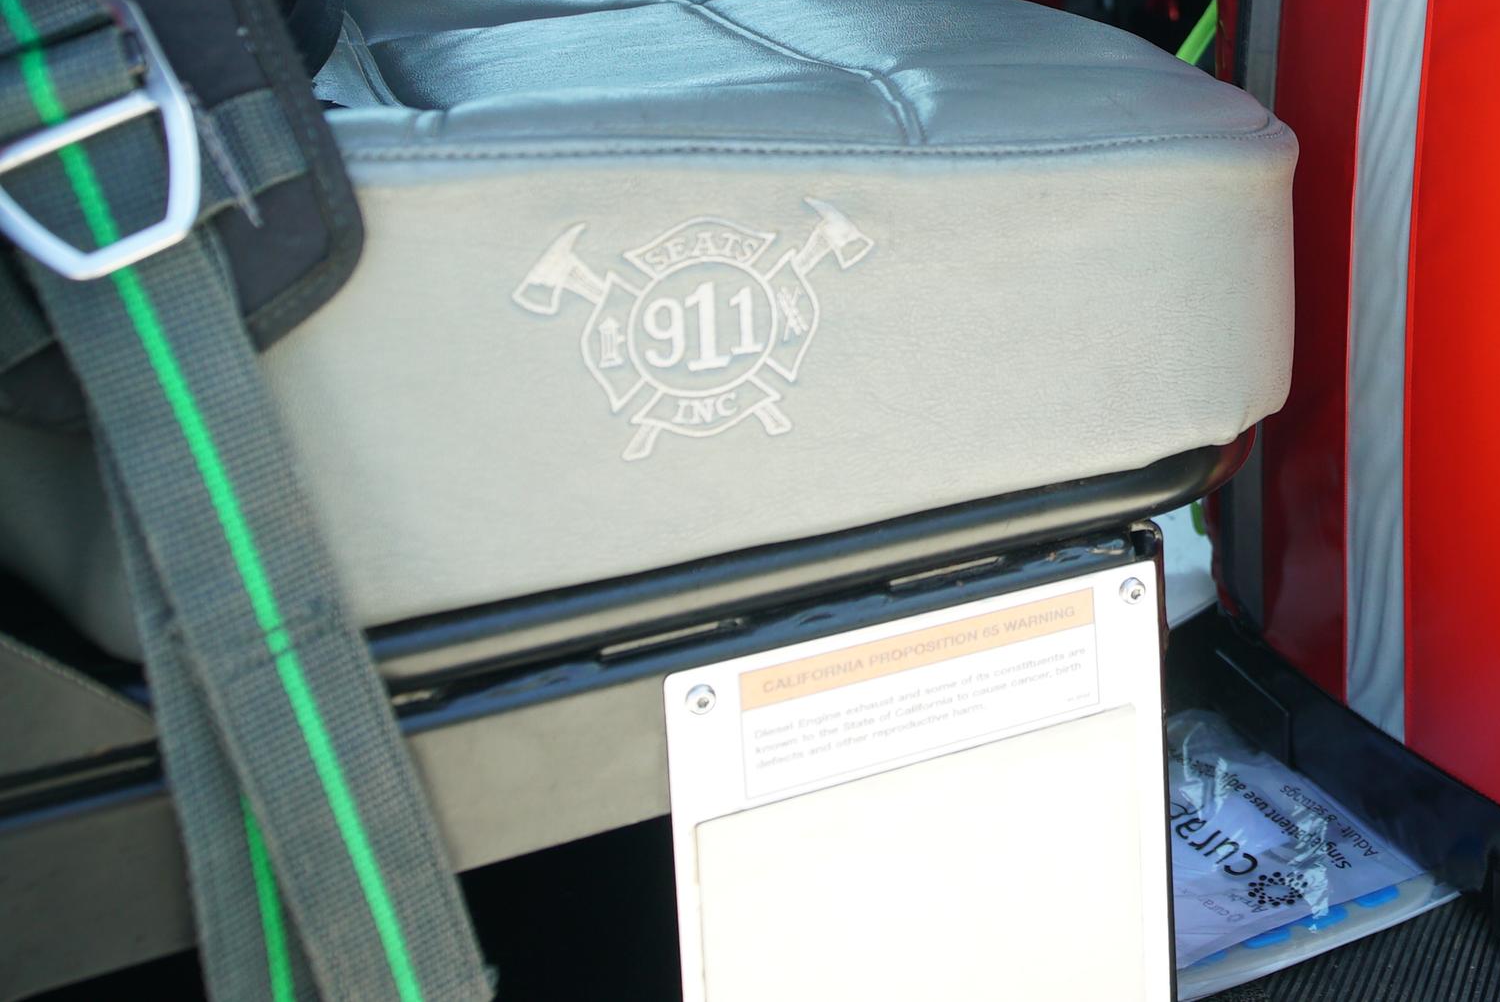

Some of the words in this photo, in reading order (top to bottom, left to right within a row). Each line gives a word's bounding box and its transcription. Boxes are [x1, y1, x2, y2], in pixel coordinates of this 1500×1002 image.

[644, 232, 758, 271] SEATS
[642, 281, 764, 371] 911
[672, 392, 738, 425] INC
[762, 658, 864, 693] CALIFORNIA
[869, 629, 978, 667] PROPOSITION
[982, 624, 1000, 638] 65
[1003, 606, 1075, 633] WARNING
[799, 711, 841, 729] Engine
[846, 695, 894, 715] exhaust
[898, 687, 921, 702] and
[924, 681, 958, 694] some
[961, 675, 973, 685] of
[976, 672, 990, 681] its
[993, 653, 1065, 677] constituents
[1068, 647, 1086, 658] are
[802, 732, 815, 742] to
[819, 726, 839, 738] the
[843, 716, 875, 731] State
[879, 710, 891, 722] of
[895, 695, 953, 717] California
[957, 693, 969, 702] to
[972, 682, 1008, 697] cause
[1055, 662, 1082, 676] birth
[756, 751, 804, 769] defects
[809, 741, 833, 756] and
[836, 732, 868, 748] other
[872, 712, 949, 740] reproductive
[1242, 790, 1269, 811] use
[1340, 826, 1380, 857] Adult
